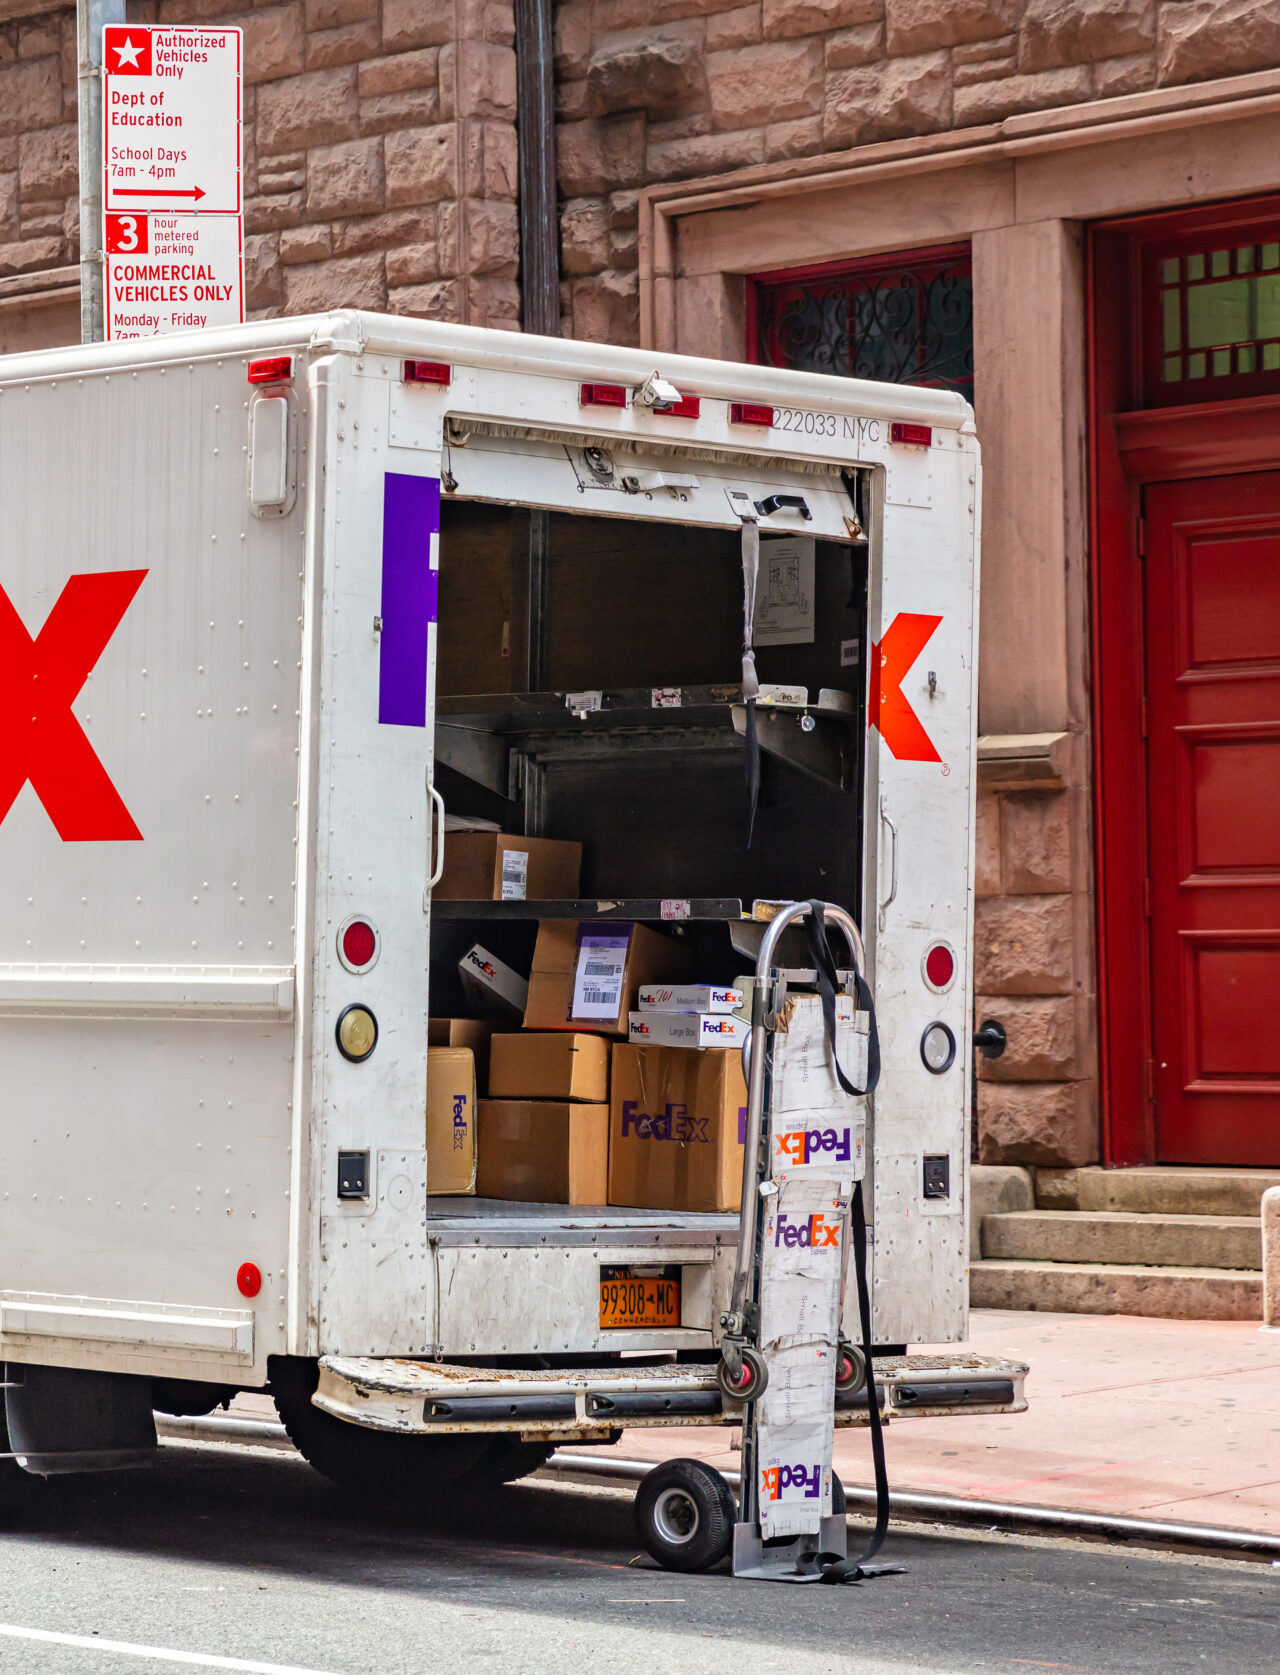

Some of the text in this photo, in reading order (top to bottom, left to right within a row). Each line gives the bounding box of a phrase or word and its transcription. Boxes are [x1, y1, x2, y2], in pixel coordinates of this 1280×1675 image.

[156, 34, 226, 48] Authorized
[156, 49, 208, 62] Vehicles
[155, 63, 184, 80] Only
[111, 90, 165, 108] Dept of
[111, 111, 183, 127] Education
[111, 146, 187, 163] School Days
[111, 163, 136, 177] 7am
[148, 164, 176, 180] 4pm
[154, 217, 178, 229] hour
[116, 215, 139, 252] 3
[154, 230, 199, 241] metered
[154, 243, 194, 256] parking
[114, 264, 216, 281] COMMERCIAL
[114, 285, 233, 302] VEHICLES ONLY
[114, 312, 160, 329] Monday
[171, 312, 207, 328] Friday
[773, 408, 880, 442] 222033 NYC
[467, 951, 497, 978] FedEx
[640, 994, 655, 1003] FedEx
[696, 997, 706, 1005] Box
[712, 991, 737, 1003] FedEx
[630, 1022, 650, 1034] FedEx
[669, 1027, 696, 1038] Large Box
[703, 1021, 735, 1033] FedEx
[453, 1094, 468, 1150] FedEx
[621, 1100, 710, 1143] FedEx
[775, 1128, 851, 1165] FedEx
[775, 1214, 840, 1248] FedEx
[601, 1284, 645, 1315] 99308
[761, 1464, 821, 1501] FedEx
